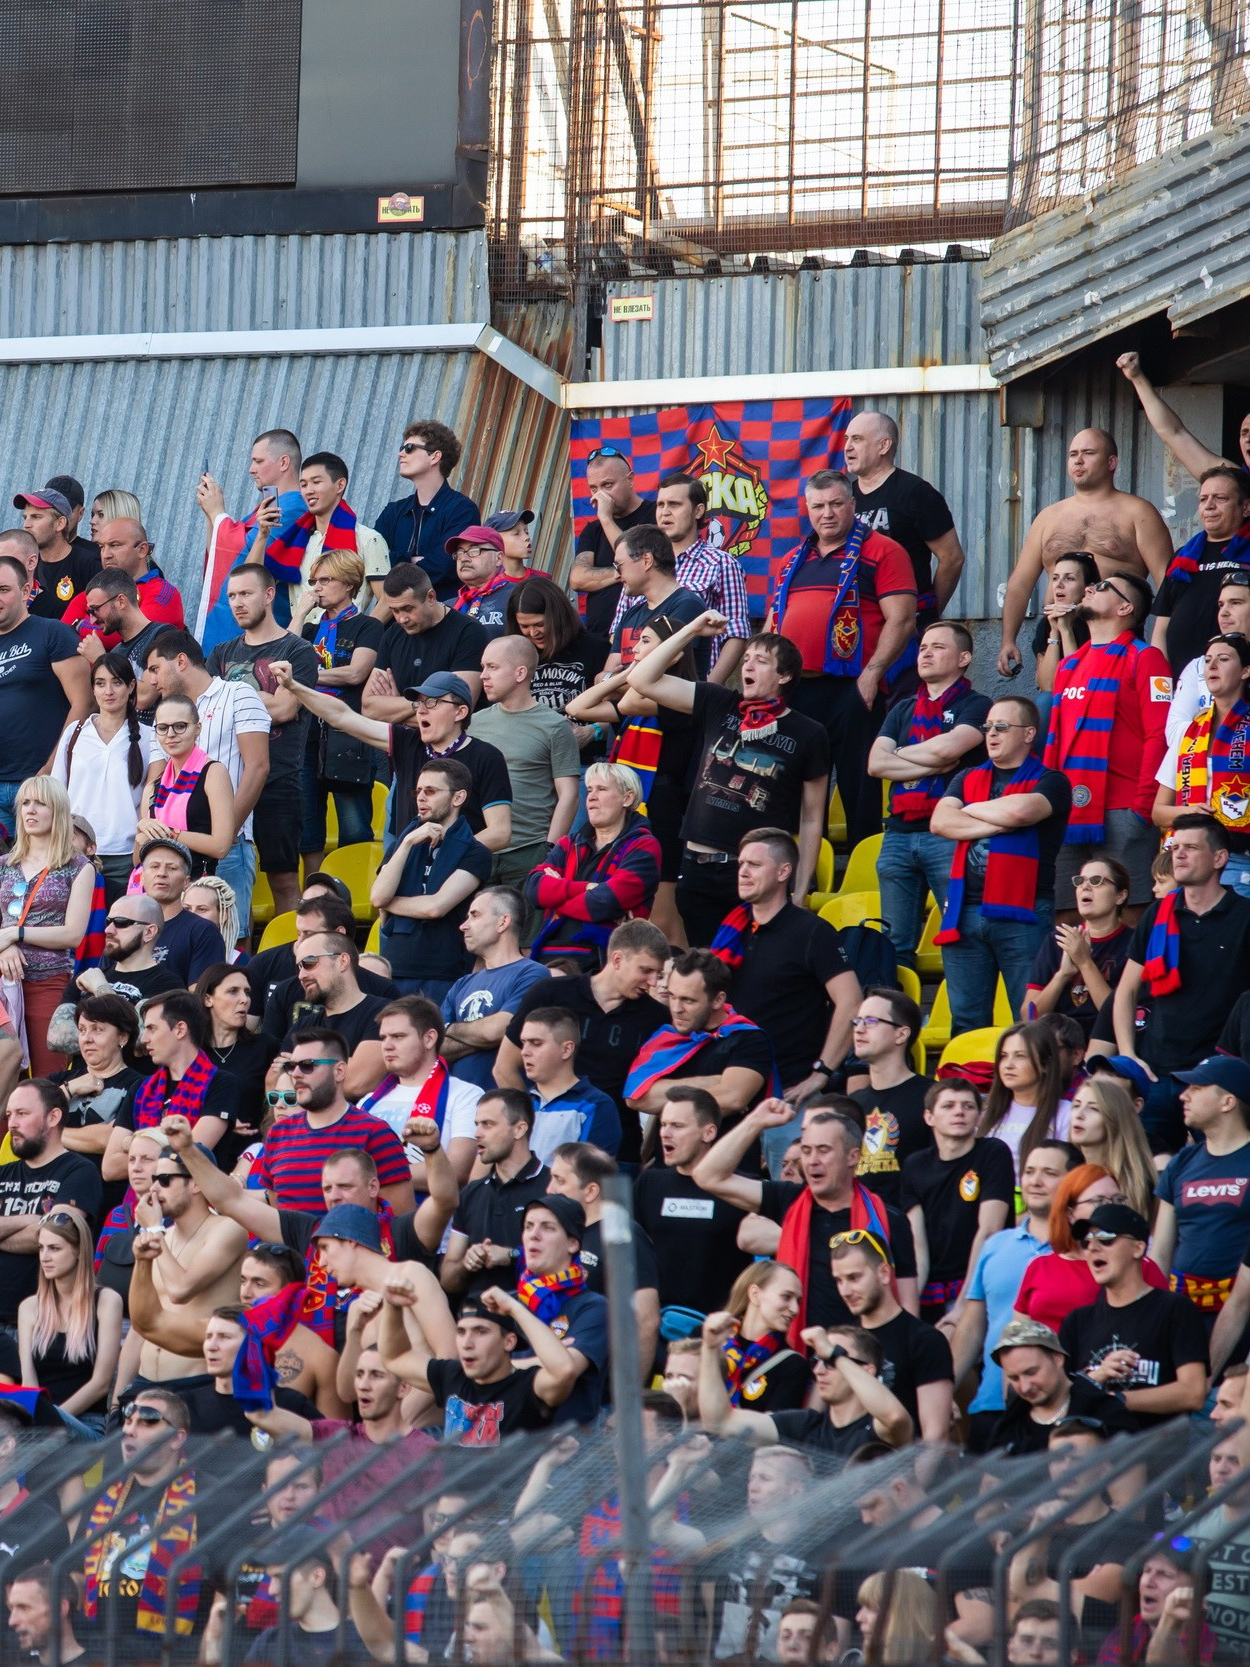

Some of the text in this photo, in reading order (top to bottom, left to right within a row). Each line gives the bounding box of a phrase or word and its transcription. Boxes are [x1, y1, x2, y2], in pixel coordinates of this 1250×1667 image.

[613, 304, 651, 314] НЕ ВЛЕЗАТЬ
[698, 471, 757, 517] СКА
[540, 668, 584, 686] MOSCOW
